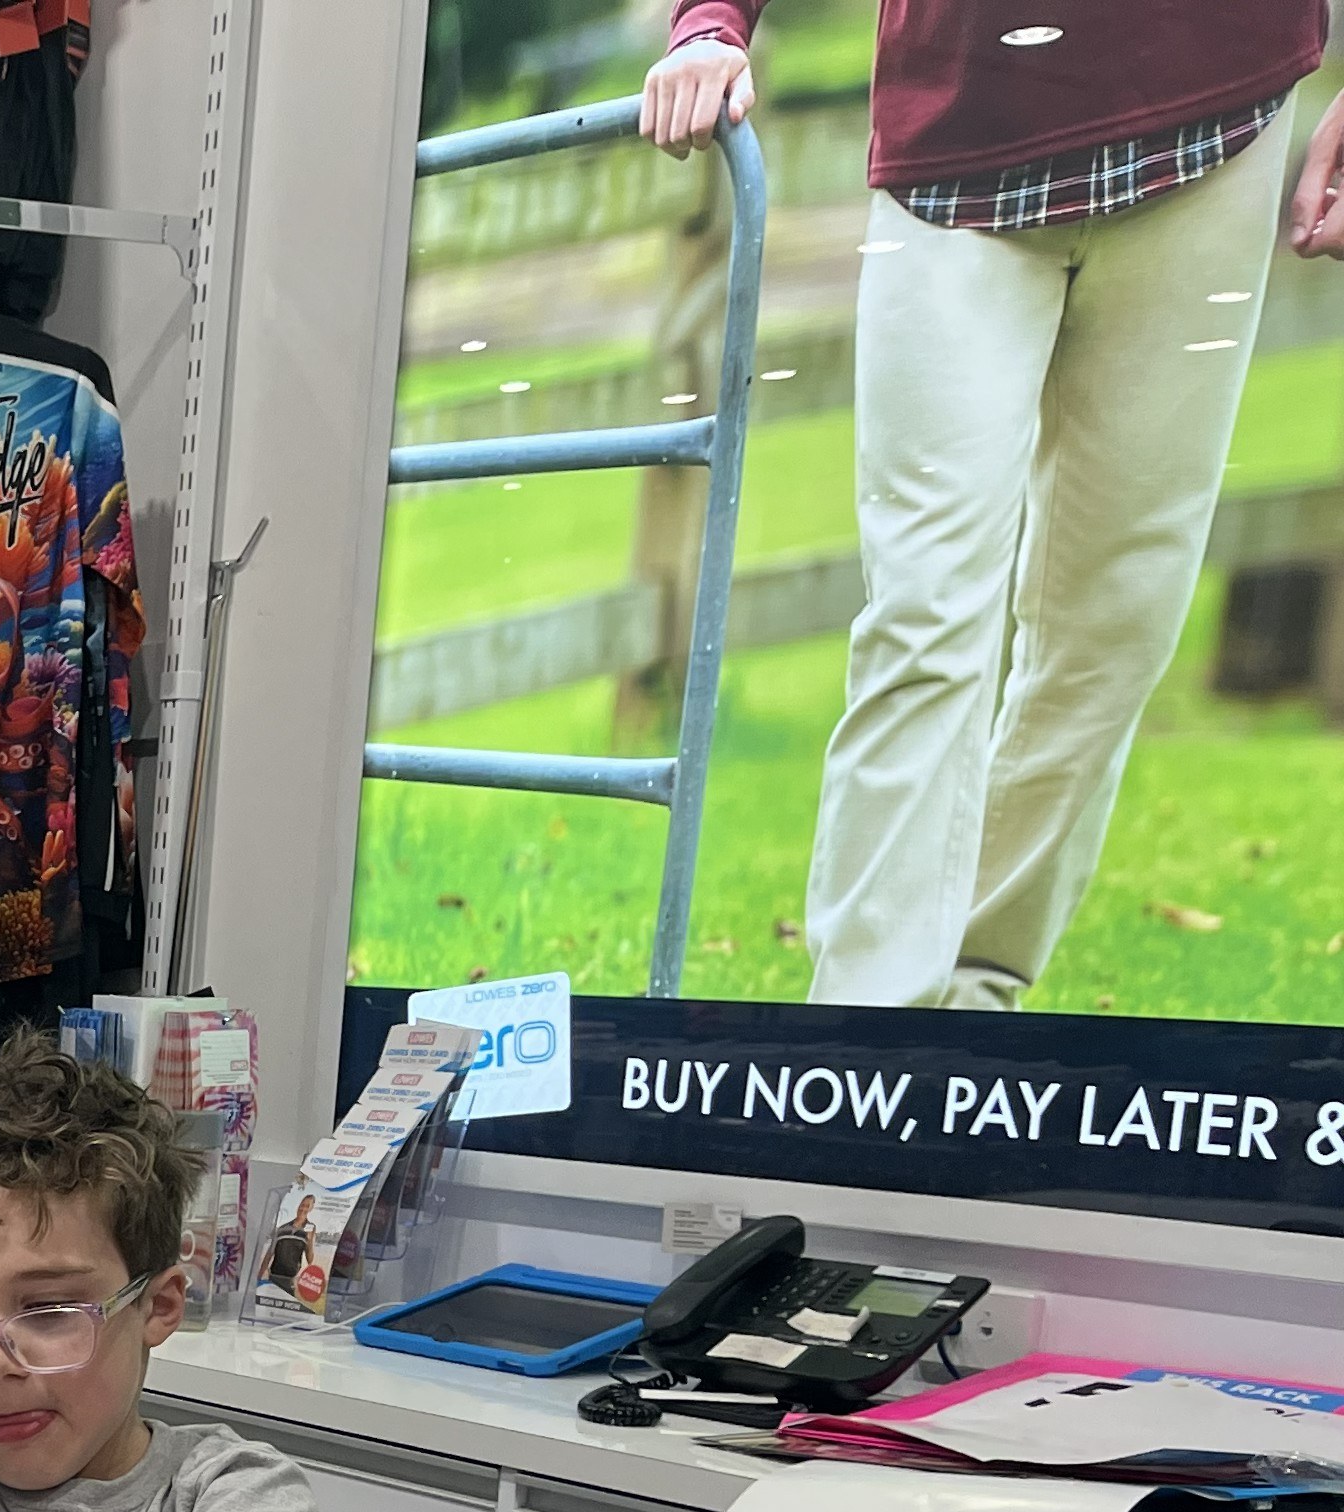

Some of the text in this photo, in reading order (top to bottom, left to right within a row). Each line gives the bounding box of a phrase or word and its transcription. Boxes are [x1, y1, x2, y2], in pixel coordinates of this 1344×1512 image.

[465, 980, 557, 1004] LOWES zero
[472, 1020, 556, 1070] ero
[622, 1057, 1344, 1166] BUY NOW, PAY LATER &
[1229, 1383, 1322, 1404] RACK
